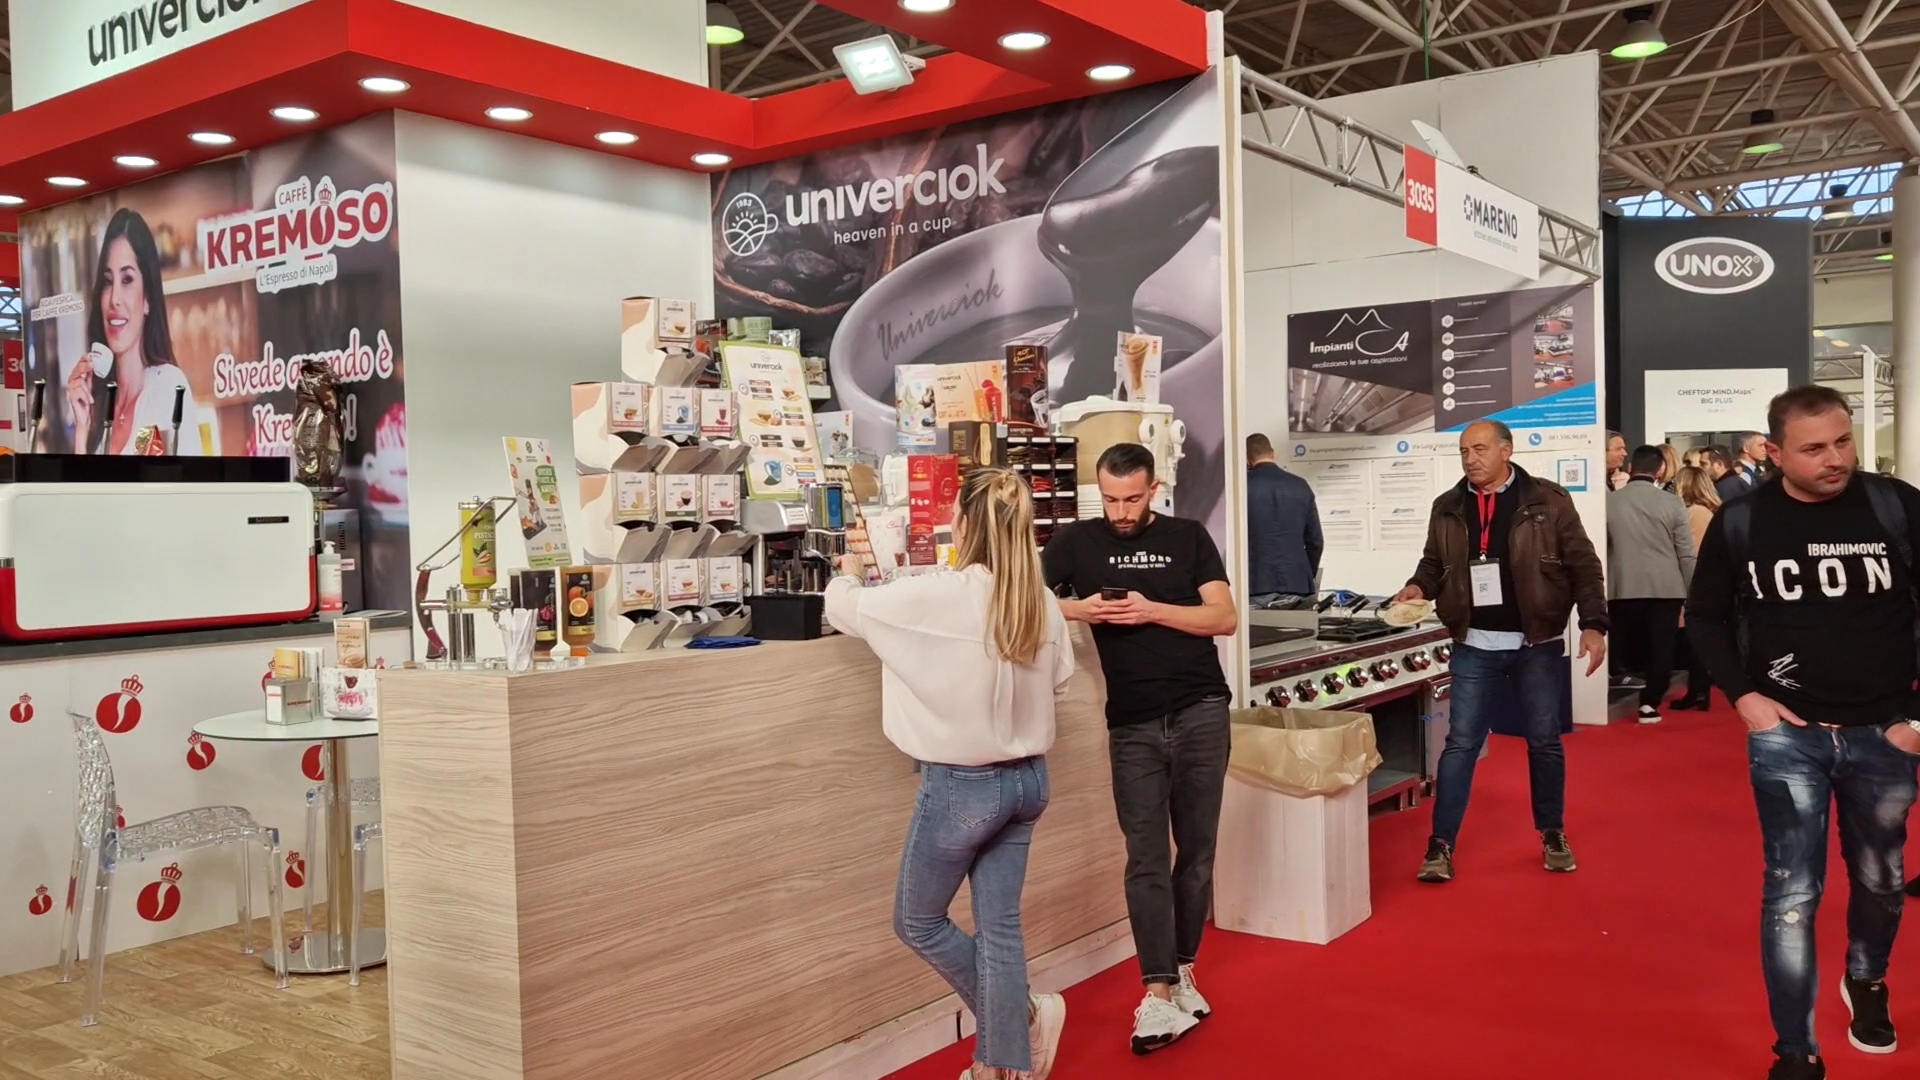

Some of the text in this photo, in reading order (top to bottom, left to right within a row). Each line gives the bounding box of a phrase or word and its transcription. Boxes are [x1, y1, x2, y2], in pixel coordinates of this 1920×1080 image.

[278, 183, 308, 206] CAFFÈ
[786, 143, 1008, 227] univerciok
[1407, 178, 1435, 214] 3035
[207, 191, 389, 270] KREMOSO
[834, 215, 952, 245] heaven in a cup
[1473, 197, 1518, 239] MARENO
[259, 261, 334, 287] L'Espresso di Napoli
[1669, 253, 1753, 278] UNOX
[877, 267, 1004, 359] Univerciok
[1309, 341, 1354, 354] Impianti
[215, 357, 234, 393] Si
[237, 345, 283, 391] vede
[378, 338, 391, 373] è
[1109, 554, 1172, 564] RICHMOND
[1808, 542, 1887, 556] IBRAHIMOVIC
[1748, 556, 1893, 601] ICON
